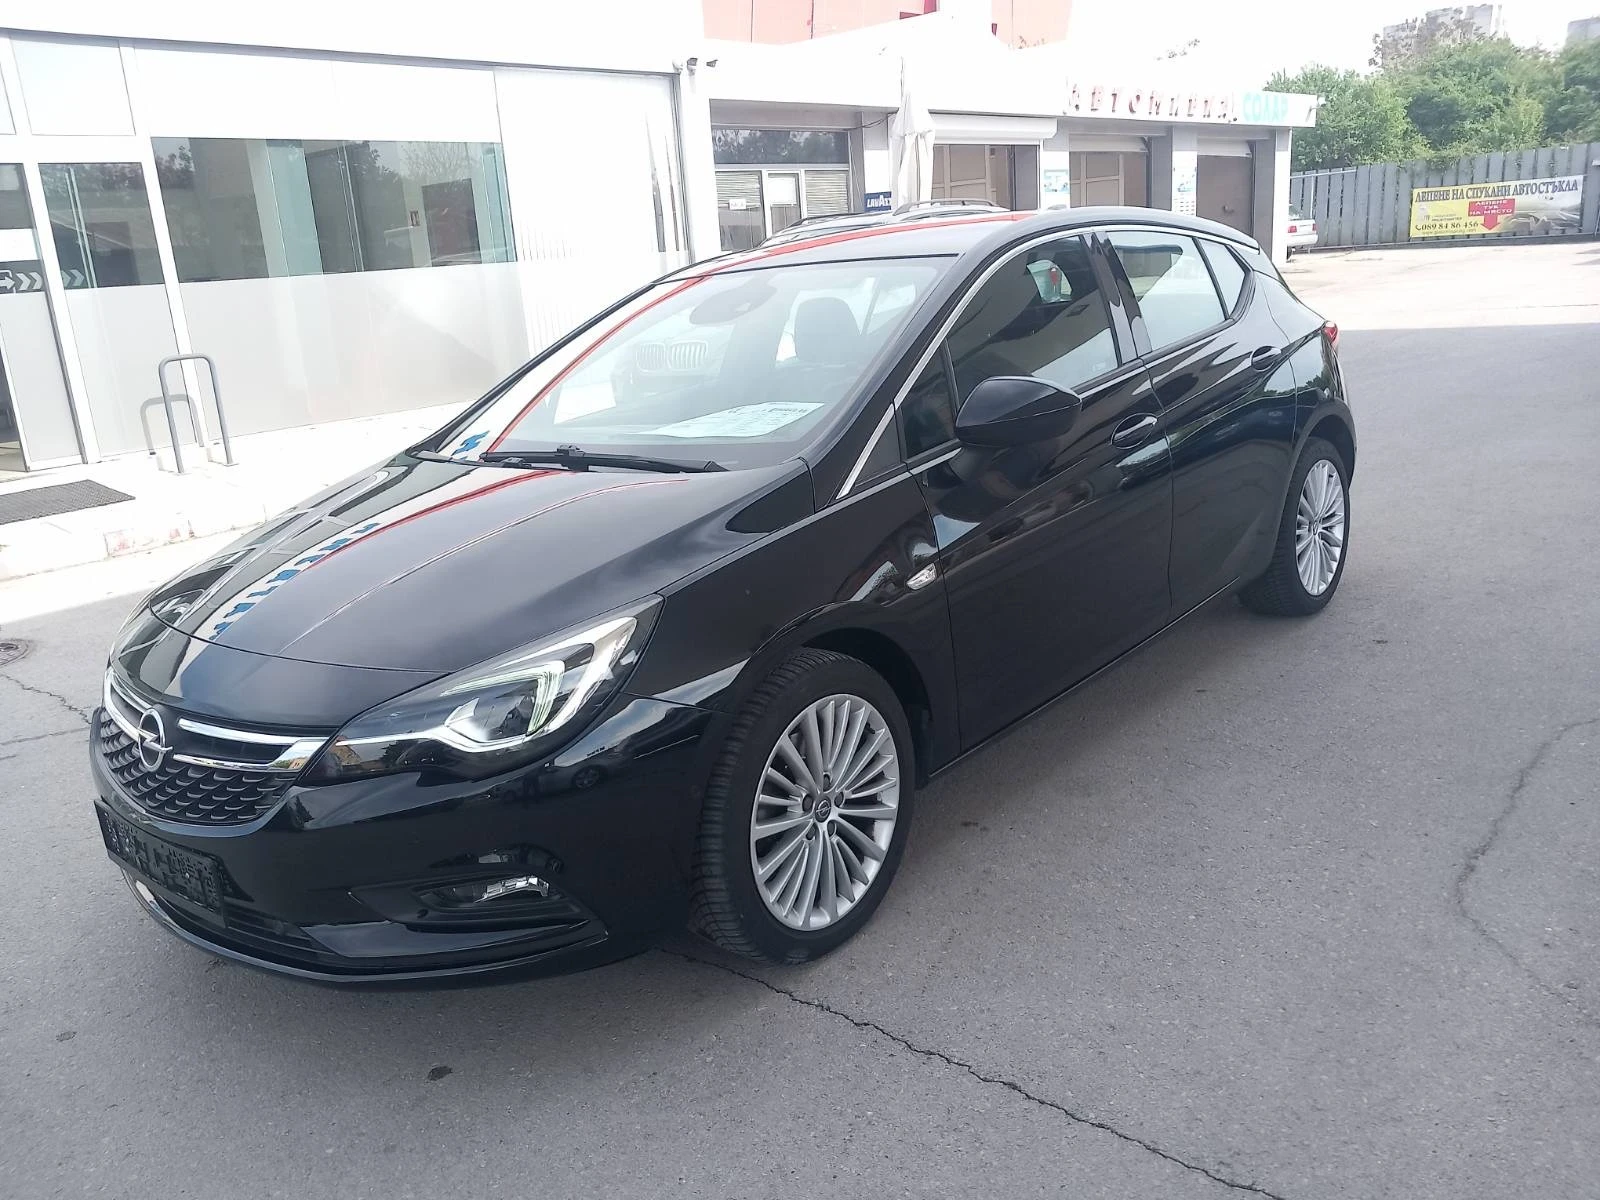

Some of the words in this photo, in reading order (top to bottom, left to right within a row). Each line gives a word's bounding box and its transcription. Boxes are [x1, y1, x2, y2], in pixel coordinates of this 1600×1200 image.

[1415, 190, 1451, 203] ЛЕПЕНЕ
[1451, 188, 1465, 201] НА
[1512, 179, 1579, 196] АВТОСТЪКЛА
[867, 195, 892, 207] LAVAZZ
[1421, 223, 1437, 231] 089
[1463, 220, 1479, 229] 456
